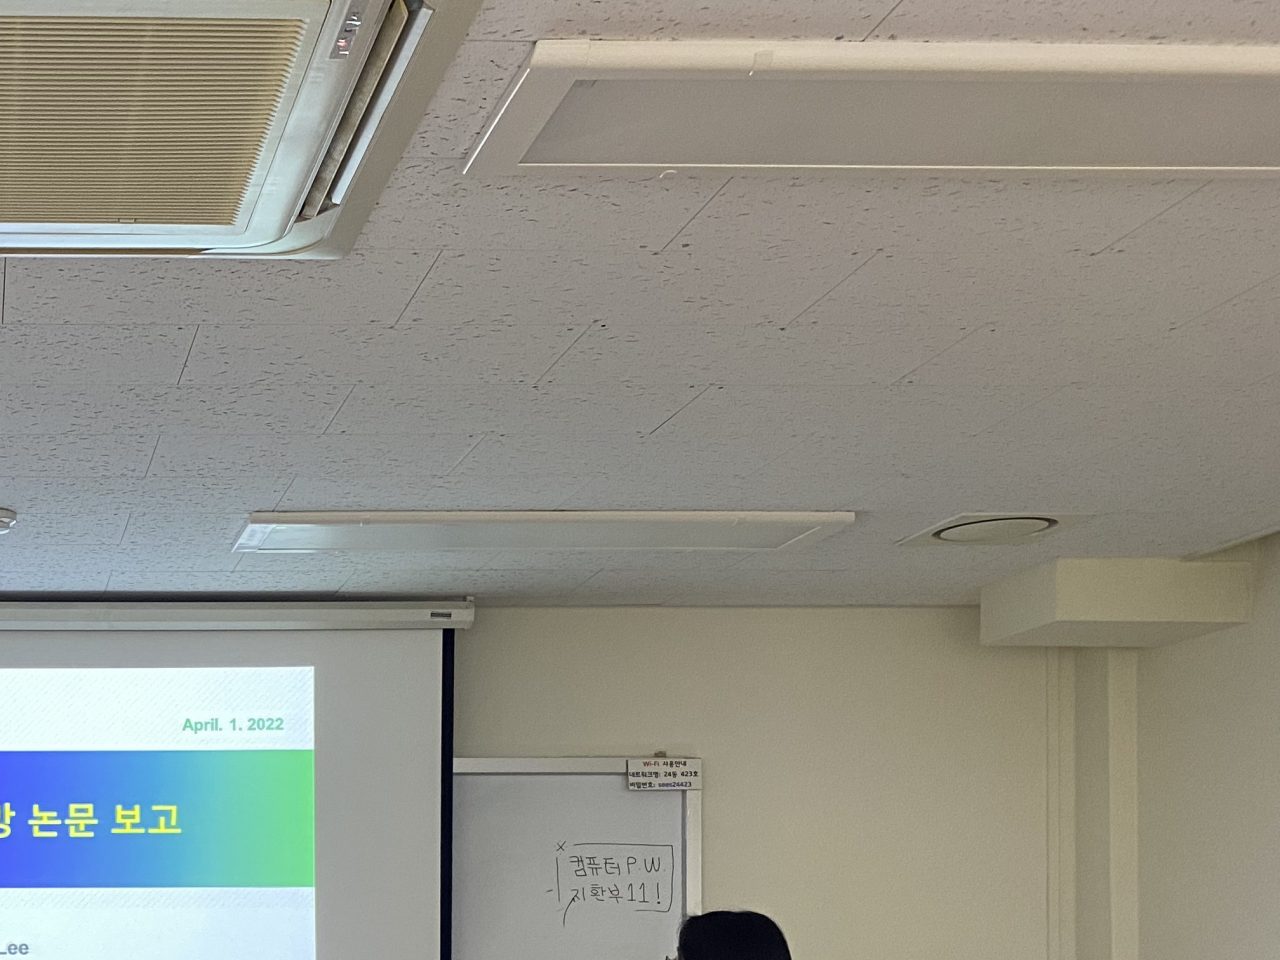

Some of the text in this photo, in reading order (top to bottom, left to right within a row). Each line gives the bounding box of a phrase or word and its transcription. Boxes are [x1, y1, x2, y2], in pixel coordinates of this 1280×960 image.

[182, 717, 284, 733] April. 1. 2022
[28, 803, 98, 838] 논문
[111, 804, 182, 836] 보고
[569, 855, 620, 877] 컴퓨터
